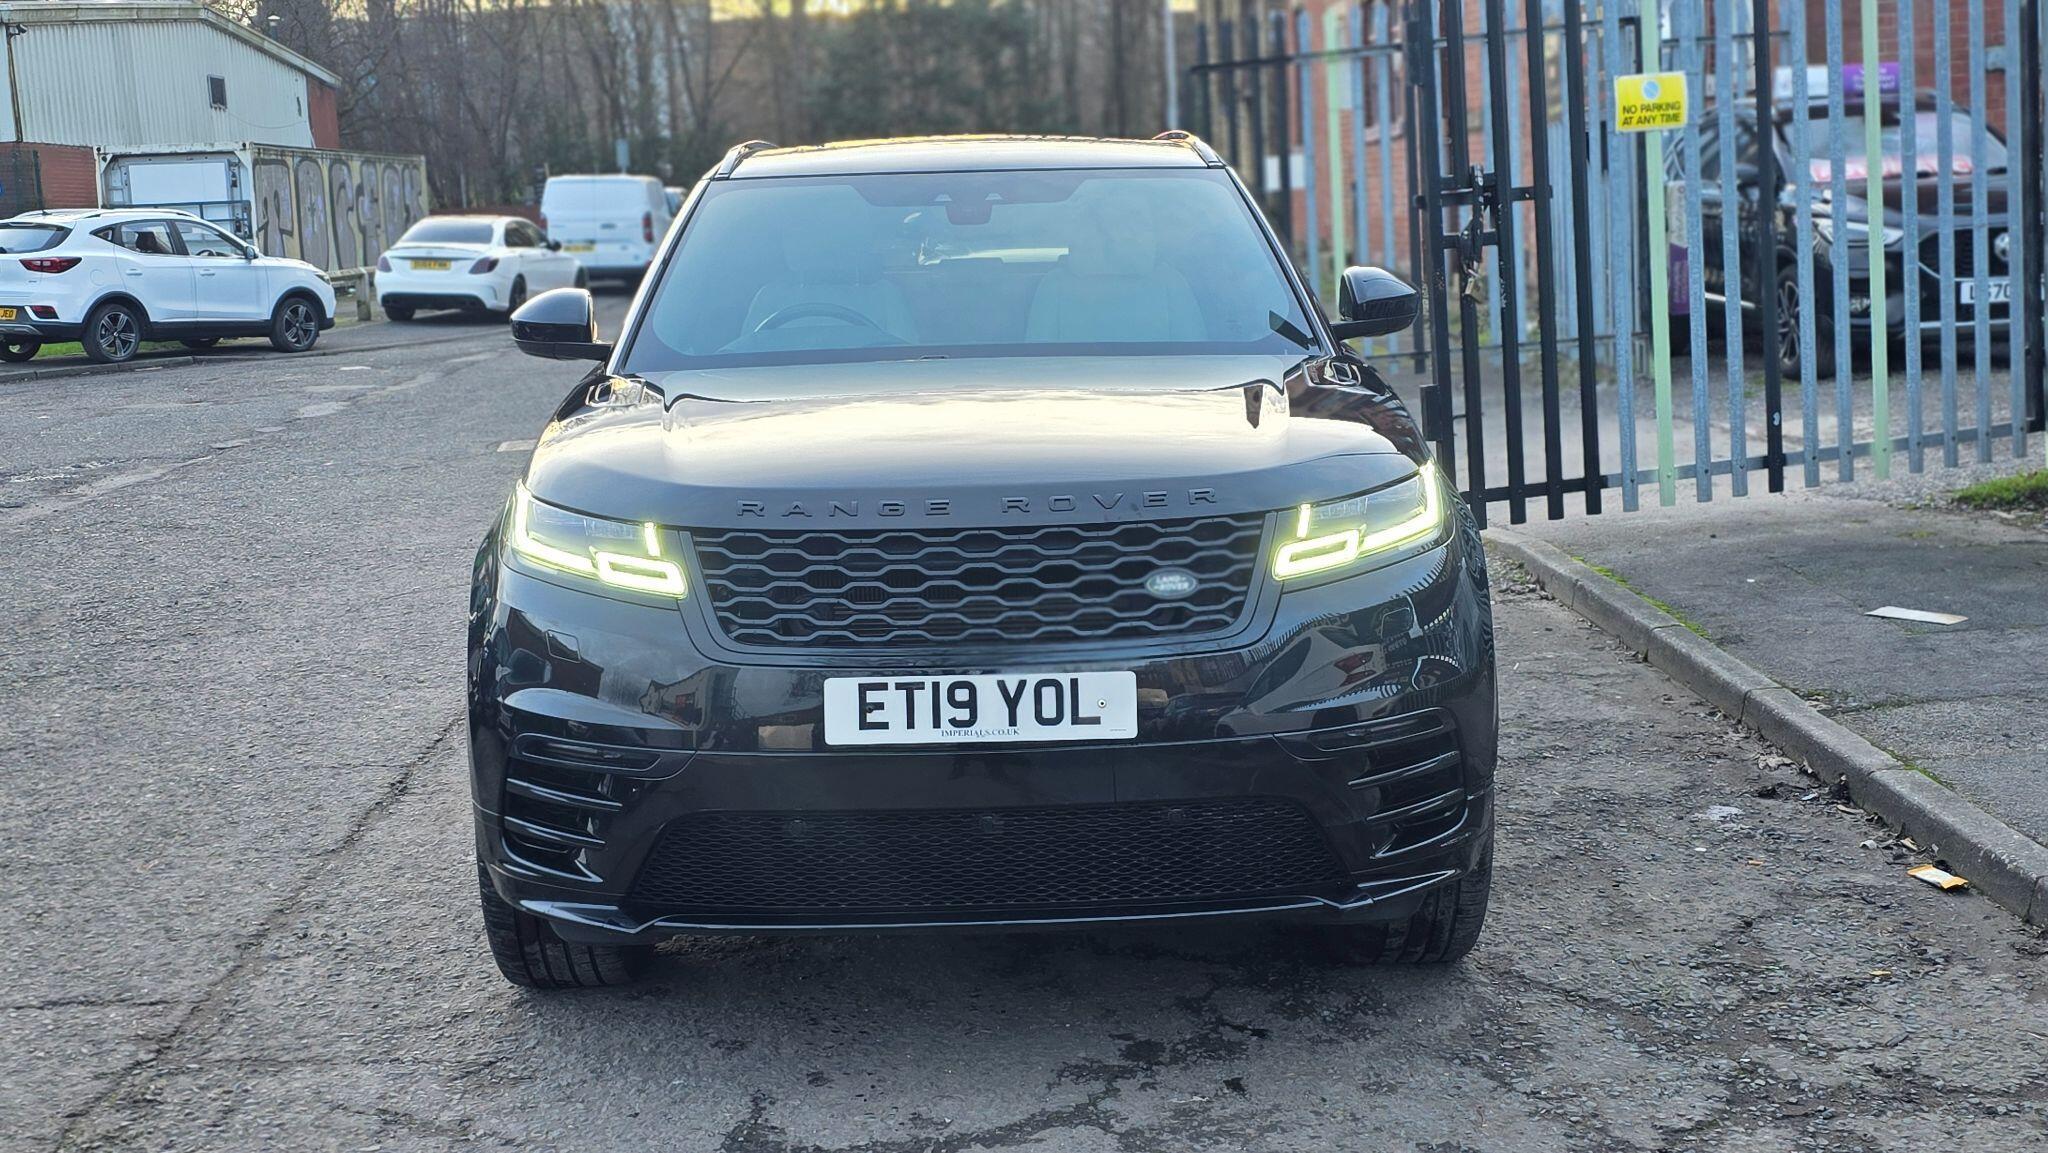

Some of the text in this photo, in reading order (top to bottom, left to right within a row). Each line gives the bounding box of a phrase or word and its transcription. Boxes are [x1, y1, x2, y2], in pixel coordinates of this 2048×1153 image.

[1622, 101, 1681, 115] NO PARKING
[1622, 112, 1681, 126] AT ANY TIME
[736, 487, 1217, 518] RANGE ROVER
[857, 677, 1102, 731] ET19 YOL
